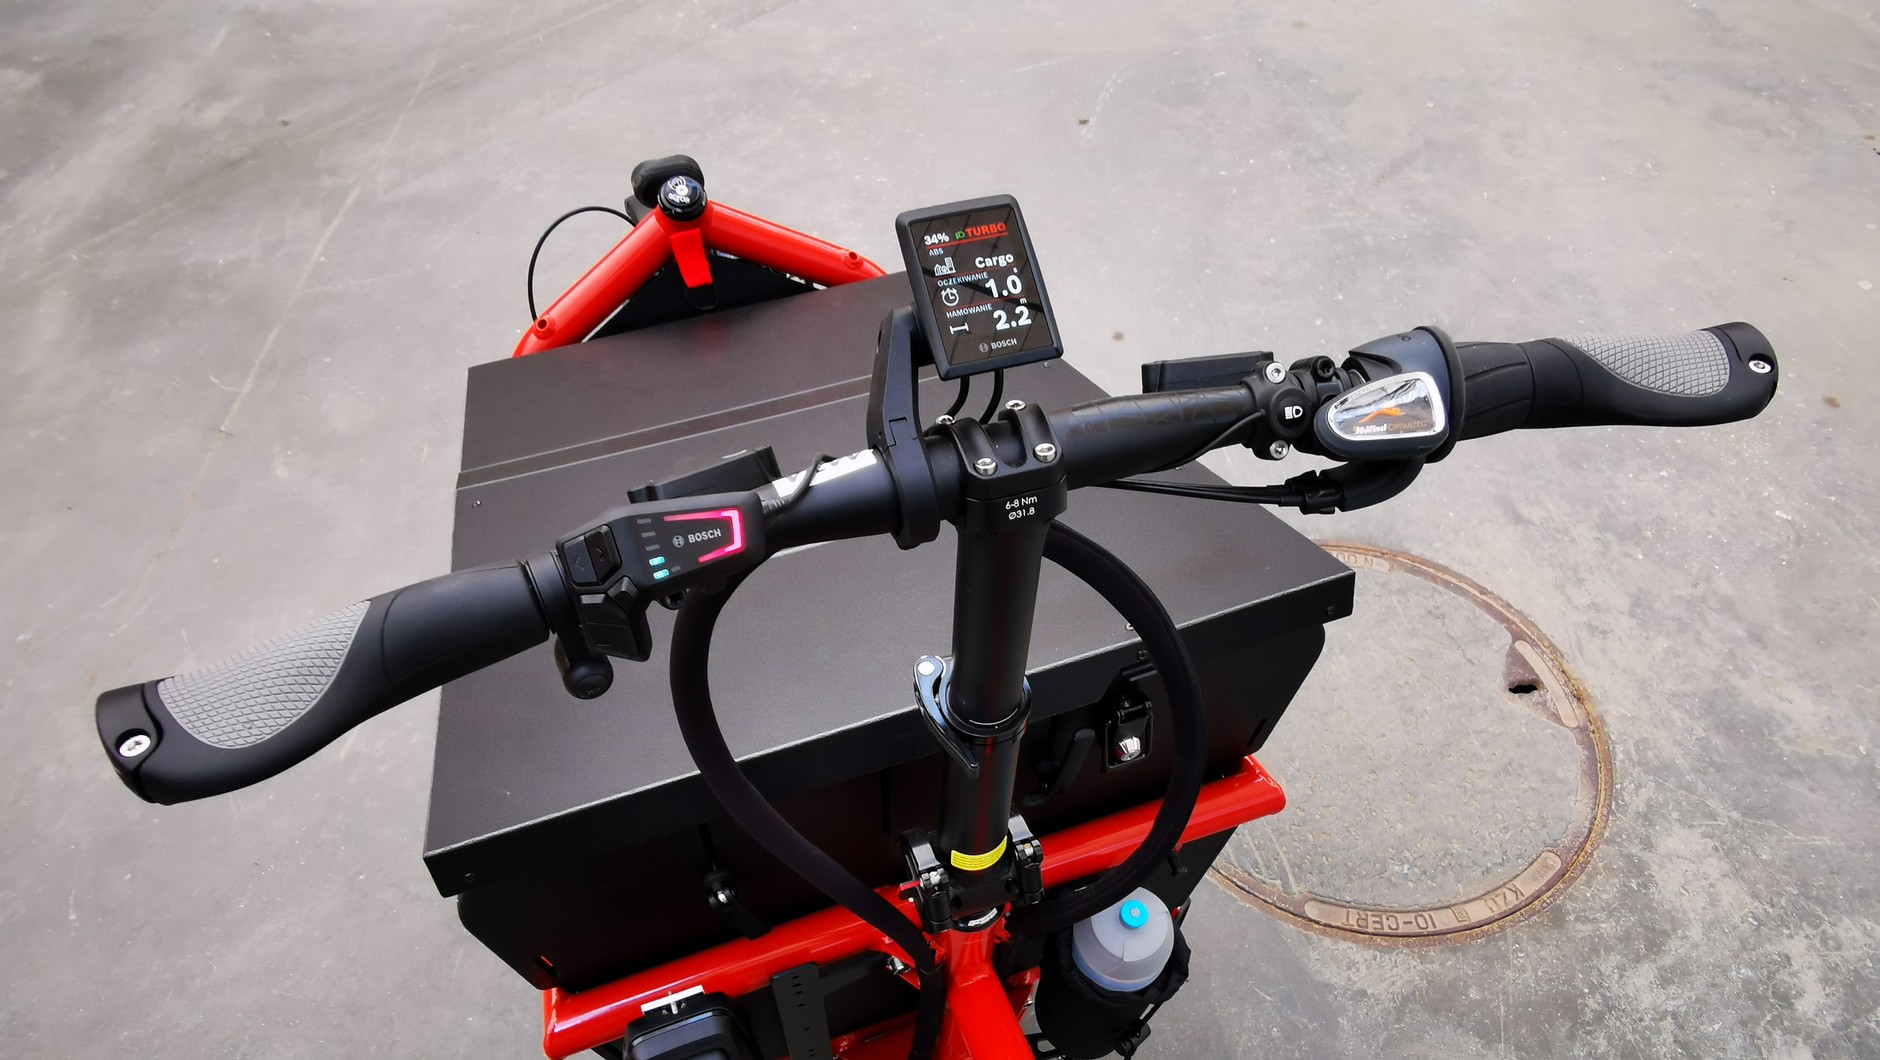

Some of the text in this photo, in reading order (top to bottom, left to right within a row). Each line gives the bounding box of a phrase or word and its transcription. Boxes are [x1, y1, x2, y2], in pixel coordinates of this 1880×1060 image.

[924, 222, 1006, 246] 34% TURBO
[929, 248, 944, 256] ABS
[975, 253, 1014, 268] Cargo
[937, 272, 988, 287] OCZEKIWANIE
[985, 275, 1022, 298] 1.0
[946, 303, 993, 318] HAMOWANIE
[993, 306, 1032, 331] 2.2
[991, 338, 1018, 349] BOSCH
[1005, 495, 1038, 510] 6-8 Nm
[1008, 506, 1036, 520] Ø31.8
[687, 528, 722, 543] BOSCH
